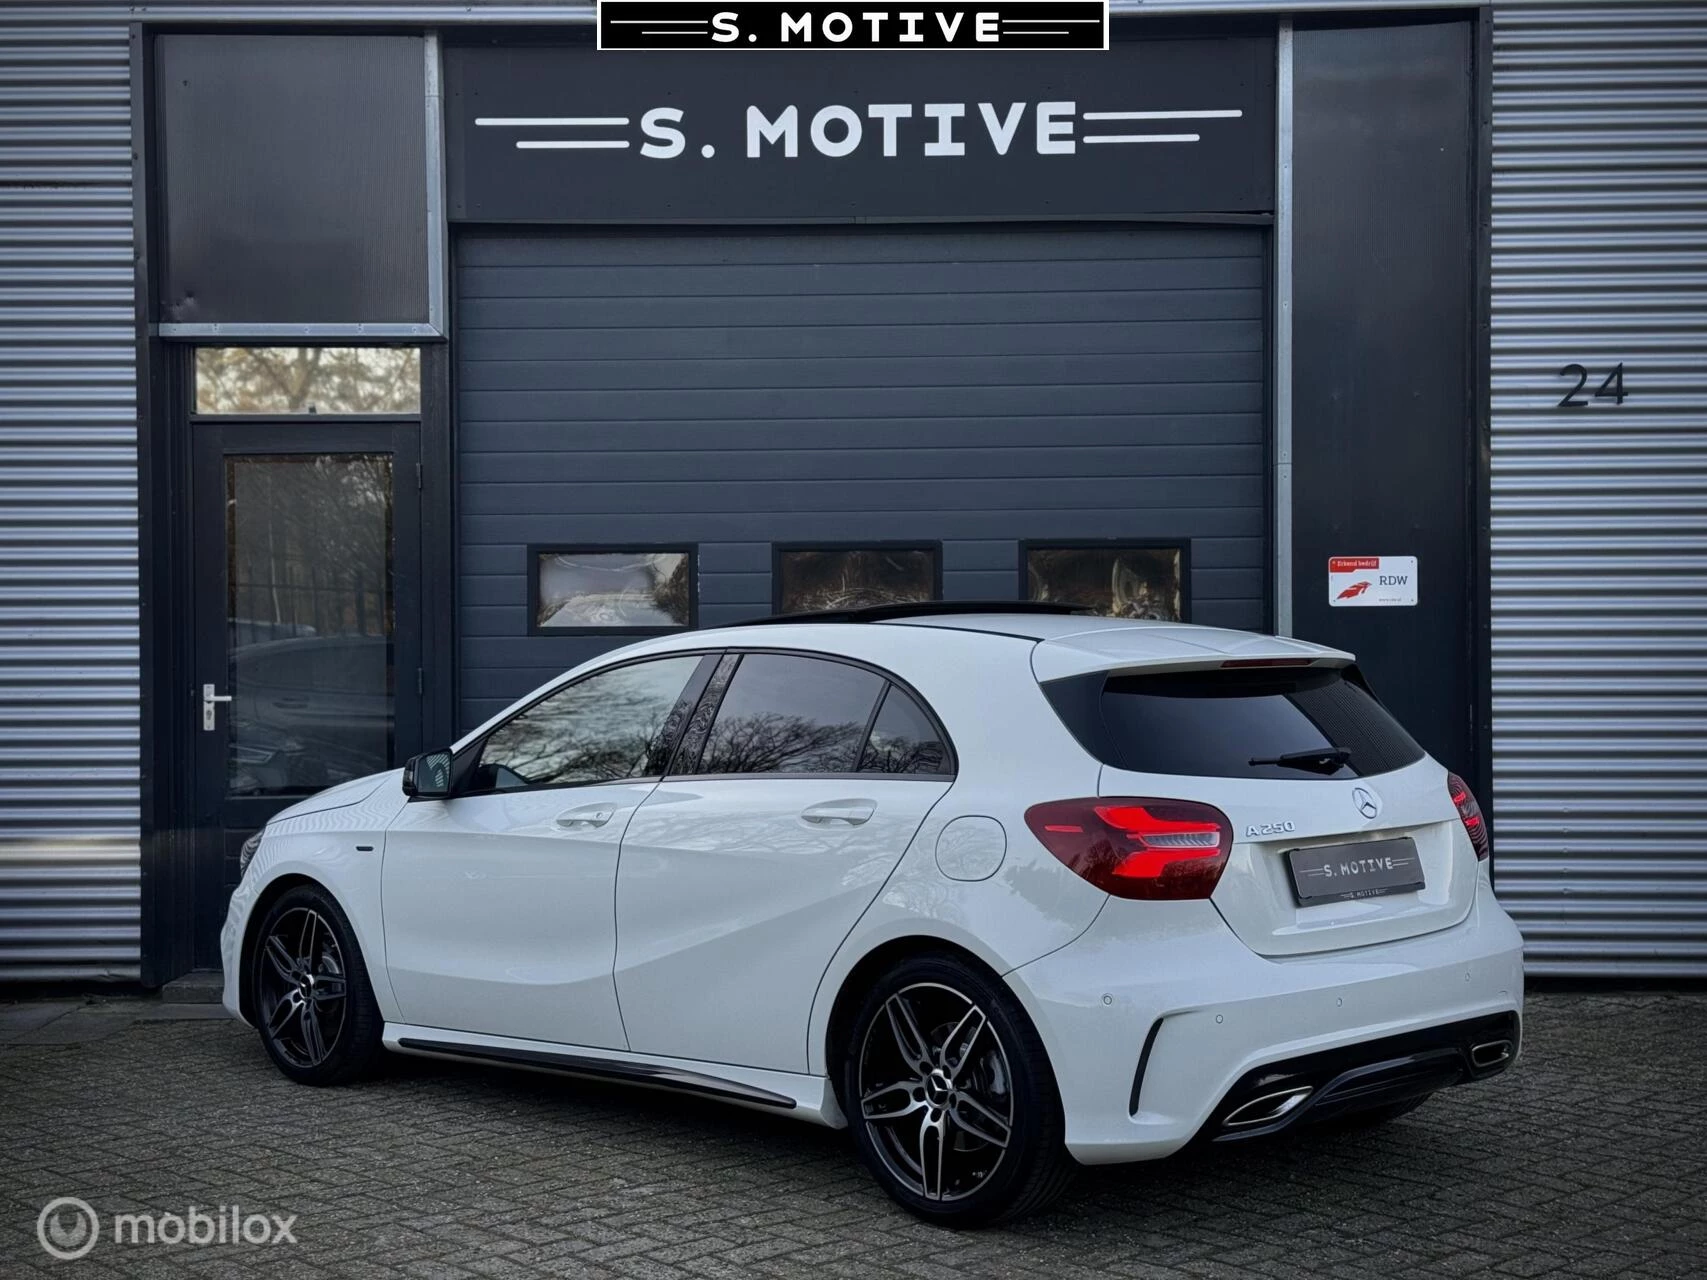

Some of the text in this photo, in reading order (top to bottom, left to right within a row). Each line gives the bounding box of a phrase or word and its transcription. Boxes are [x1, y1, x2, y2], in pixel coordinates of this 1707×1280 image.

[640, 100, 1077, 159] S. MOTIVE
[1557, 362, 1629, 407] 24
[1379, 575, 1408, 586] RDW
[1323, 857, 1394, 878] S. MOTIVE
